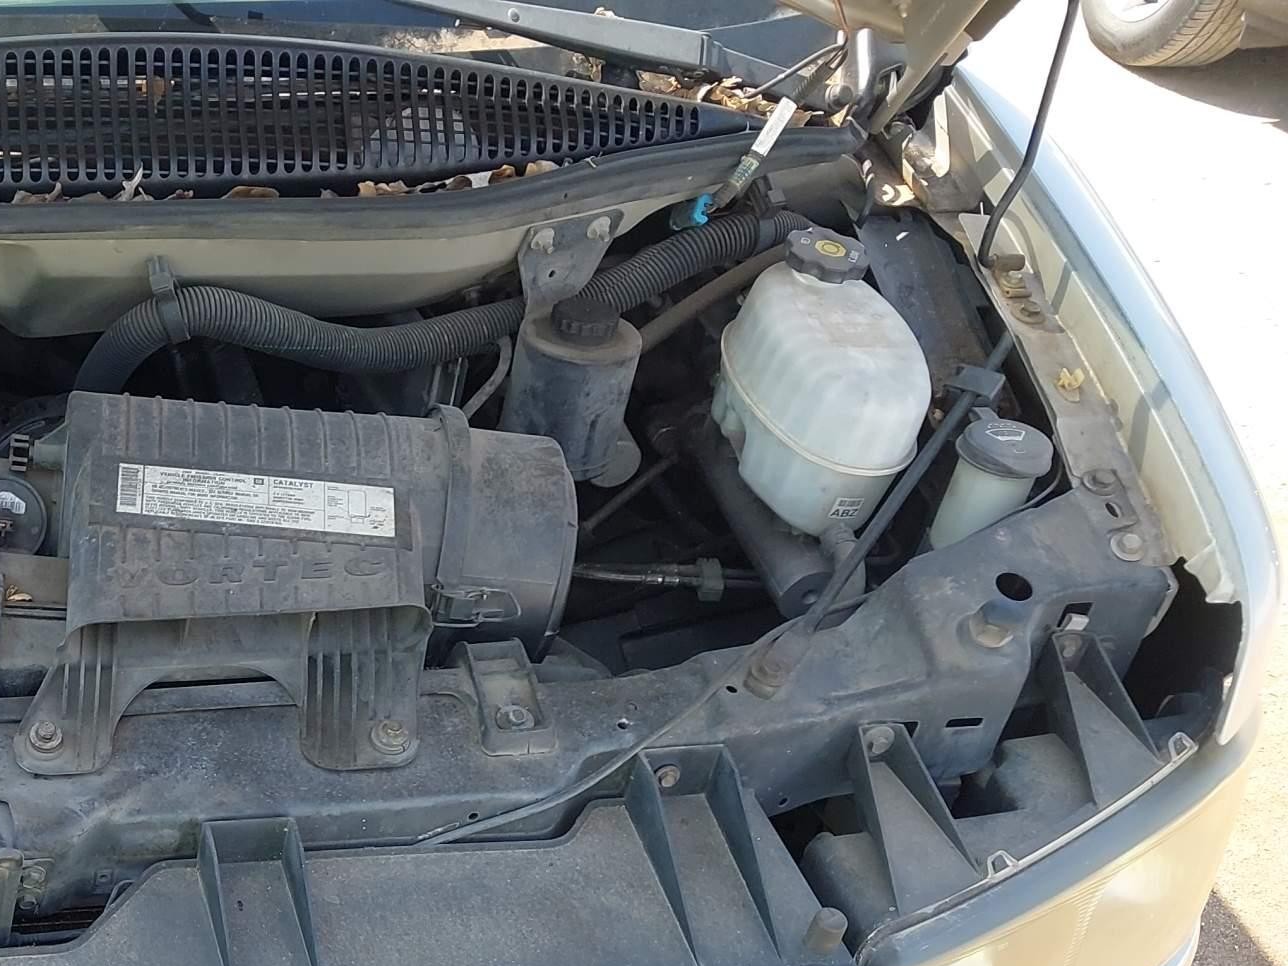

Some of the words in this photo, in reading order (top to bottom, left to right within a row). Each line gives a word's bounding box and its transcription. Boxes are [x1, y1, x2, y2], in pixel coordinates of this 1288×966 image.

[272, 479, 314, 489] CATALYST
[830, 508, 859, 518] ABZ
[115, 557, 385, 589] VORTEC
